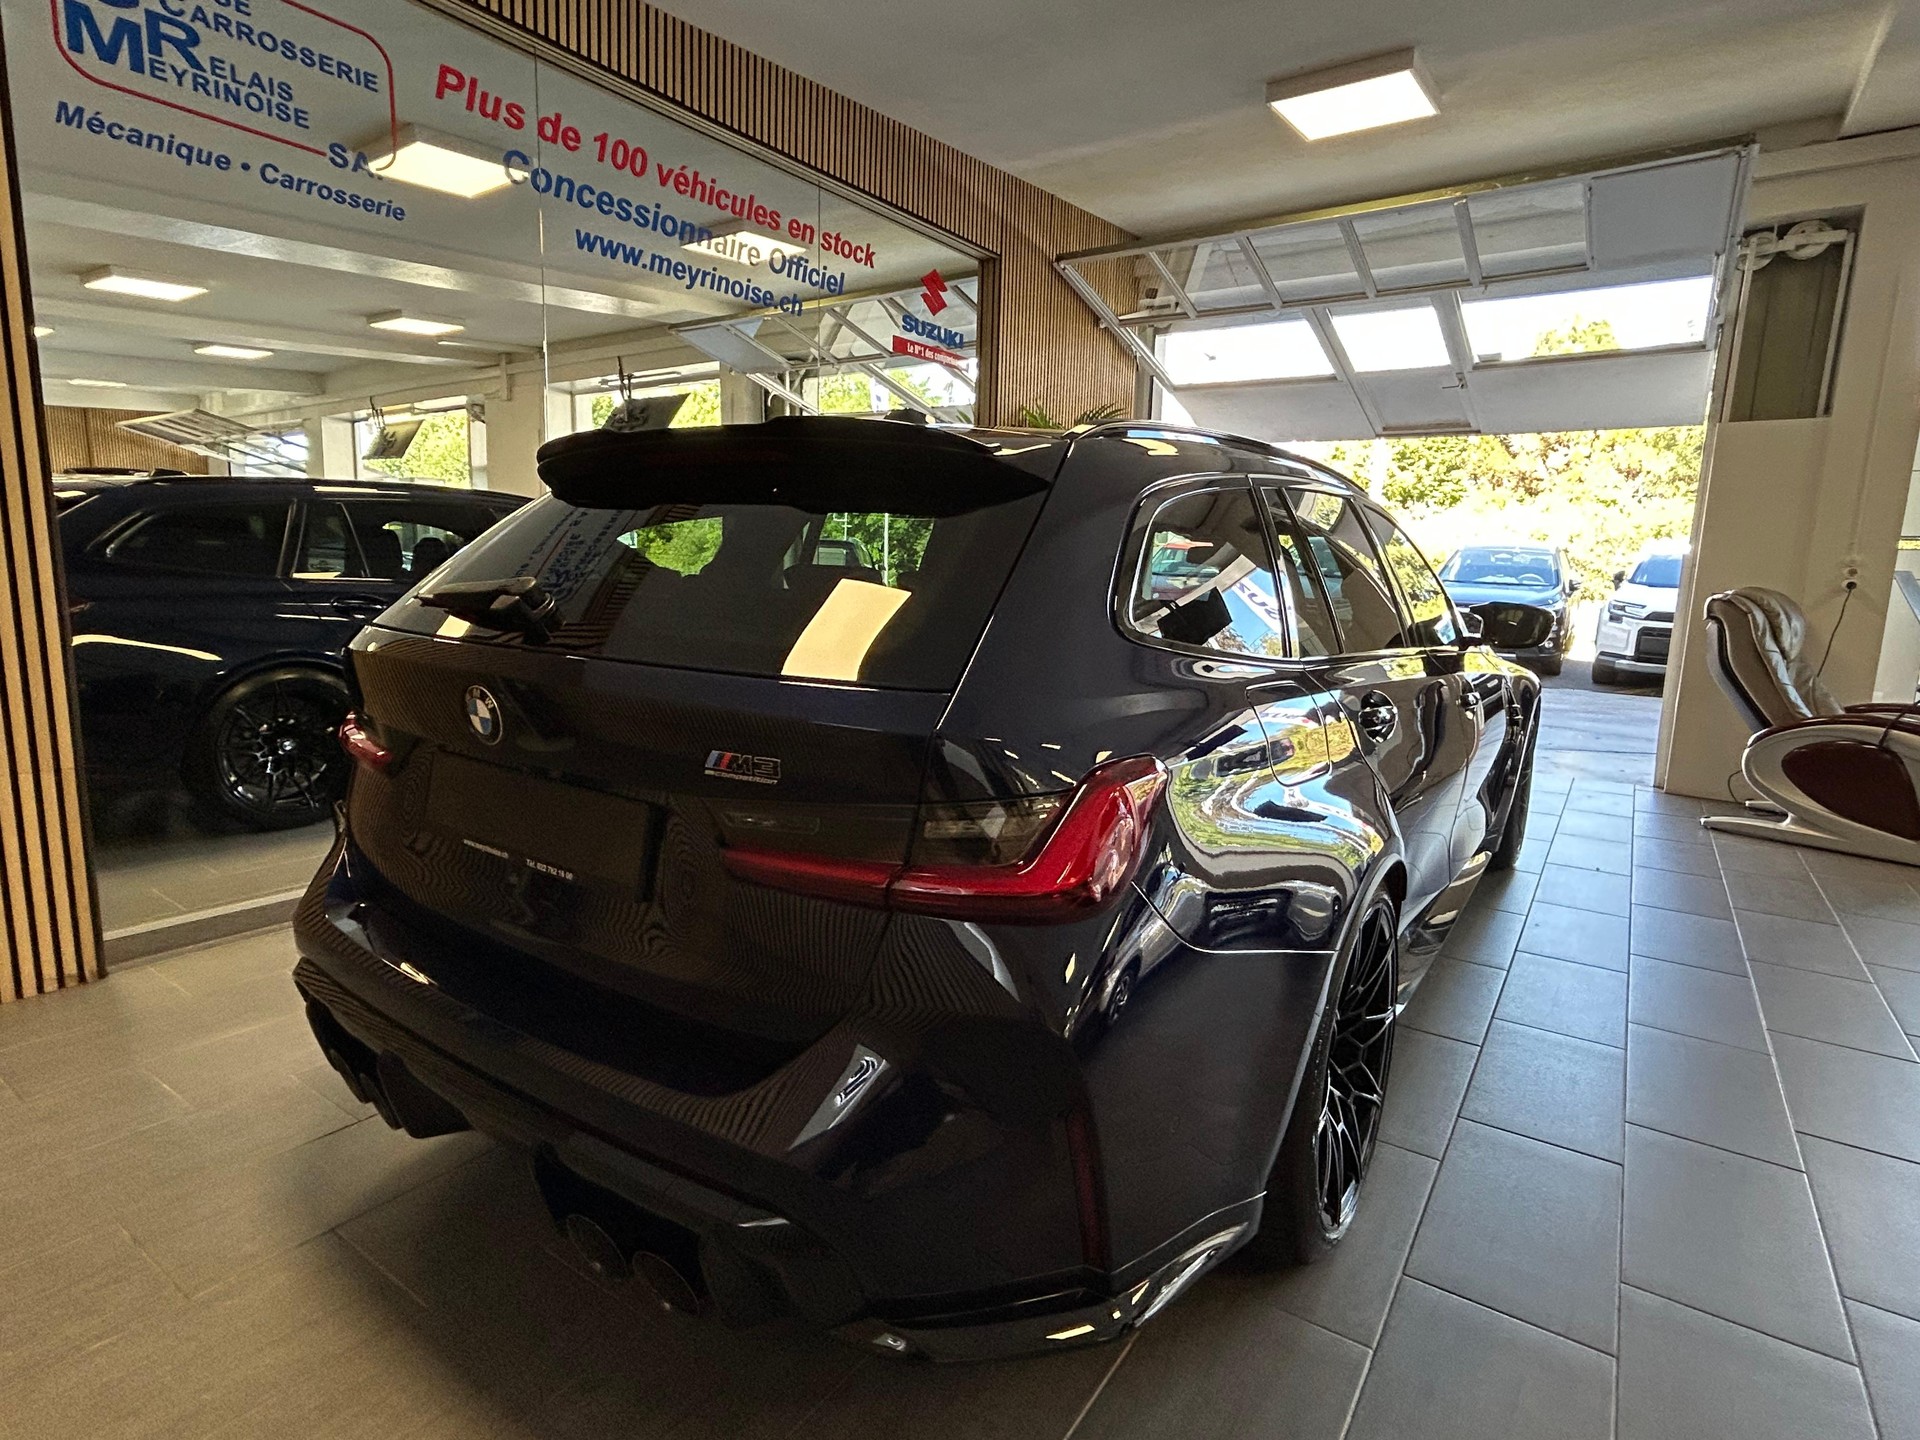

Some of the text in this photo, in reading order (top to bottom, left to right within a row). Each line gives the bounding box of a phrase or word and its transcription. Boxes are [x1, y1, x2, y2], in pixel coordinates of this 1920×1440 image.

[55, 100, 406, 221] Mécanique Carrosserie
[435, 64, 876, 269] Plus de 100 véhicules en stock
[502, 149, 845, 295] Concessionnaire Officiel
[575, 228, 803, 317] www.meyrinoise.ch
[901, 314, 964, 350] SUZUKI
